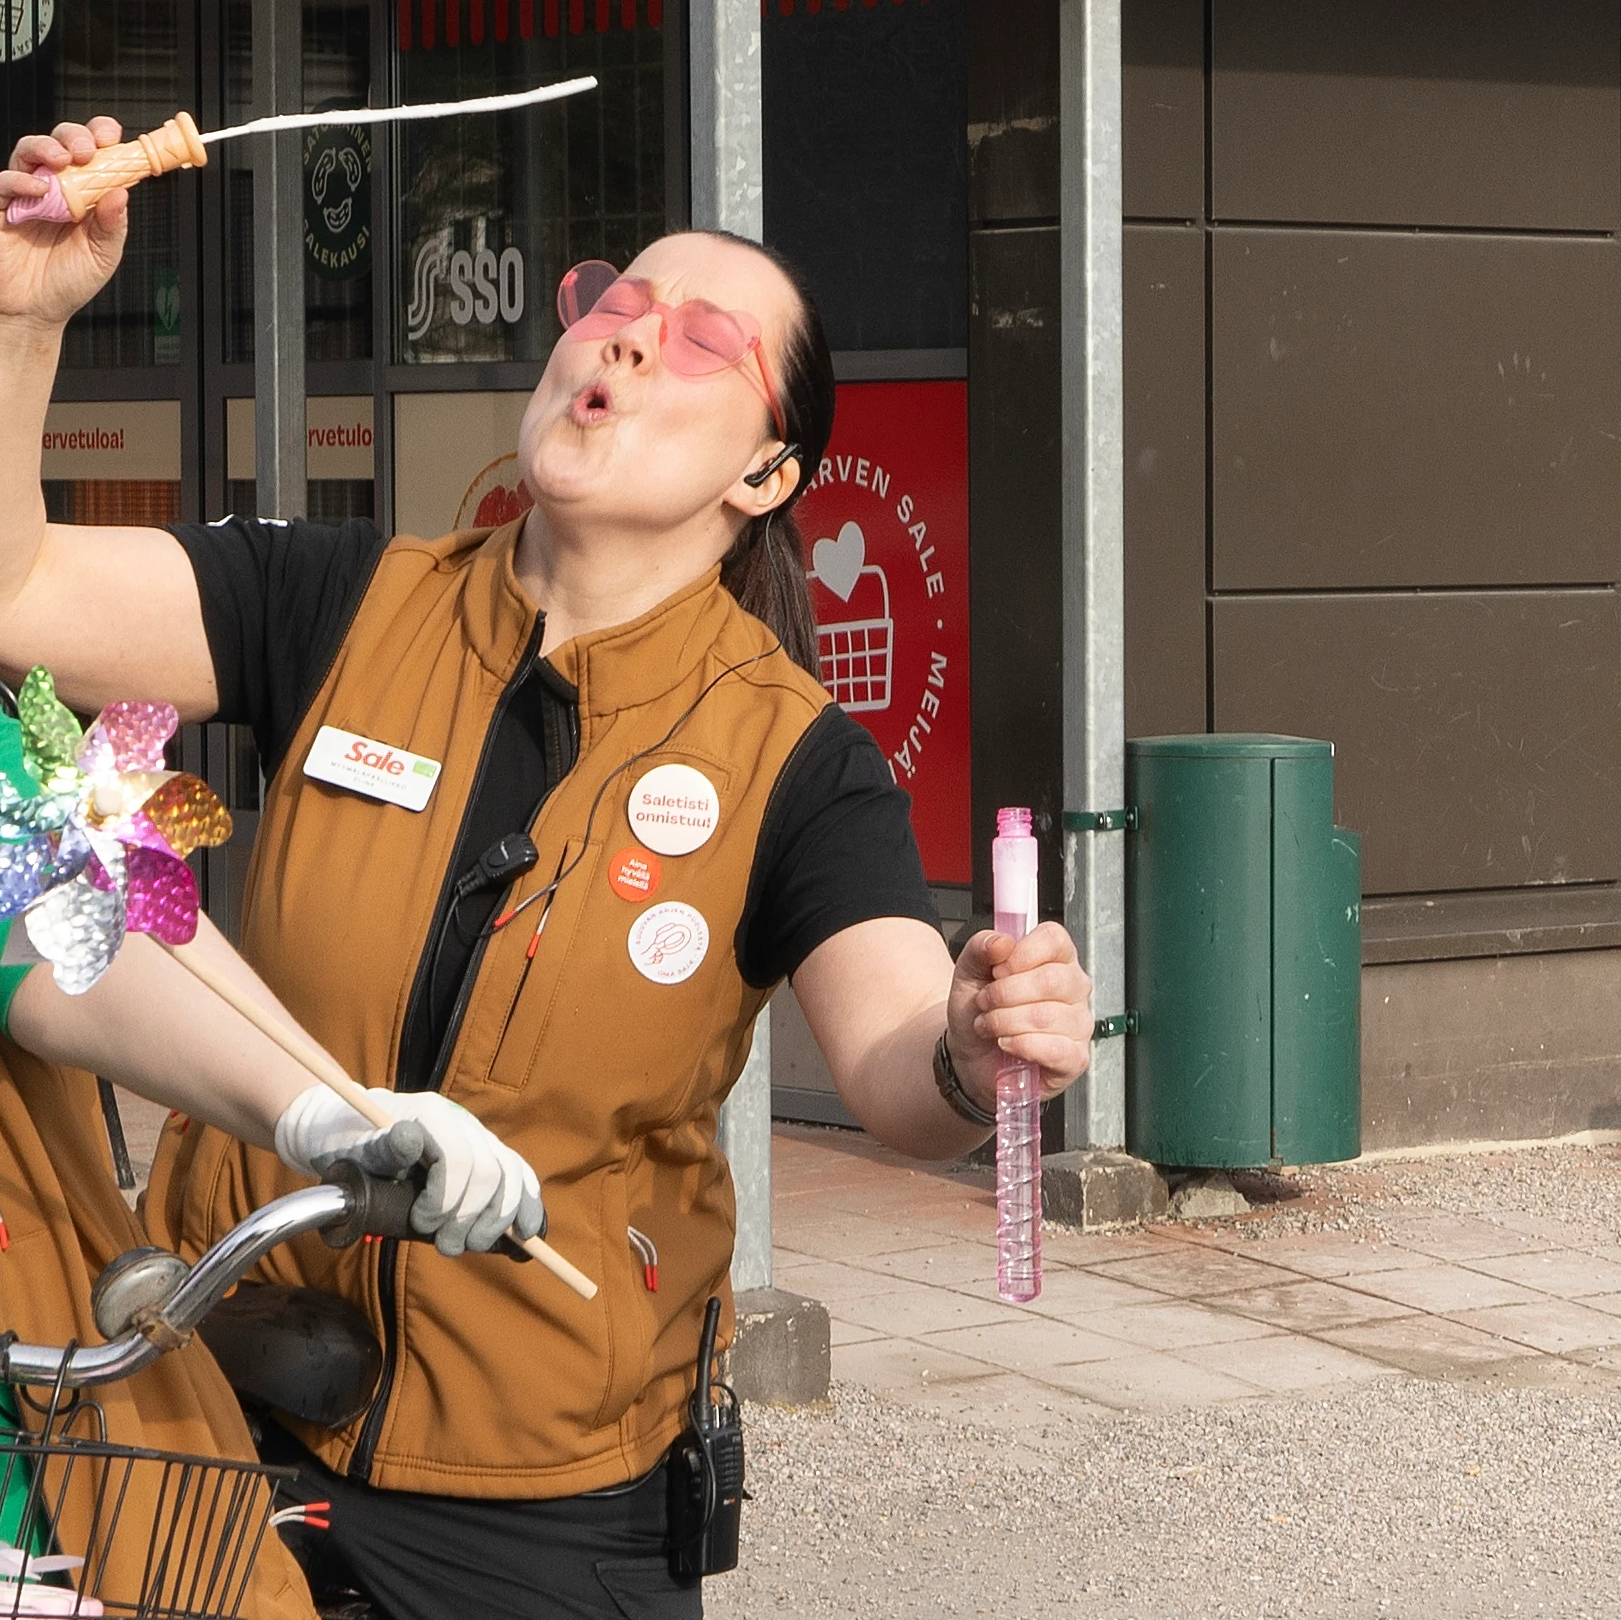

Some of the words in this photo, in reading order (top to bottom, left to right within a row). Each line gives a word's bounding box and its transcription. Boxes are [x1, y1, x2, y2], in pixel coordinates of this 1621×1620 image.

[450, 245, 524, 325] SSO
[42, 426, 125, 450] ervetuloa!
[308, 422, 374, 447] rvetulo
[896, 494, 945, 599] SALE
[343, 740, 405, 776] Sale
[641, 792, 710, 811] Saletisti
[635, 810, 712, 829] onnistuu!
